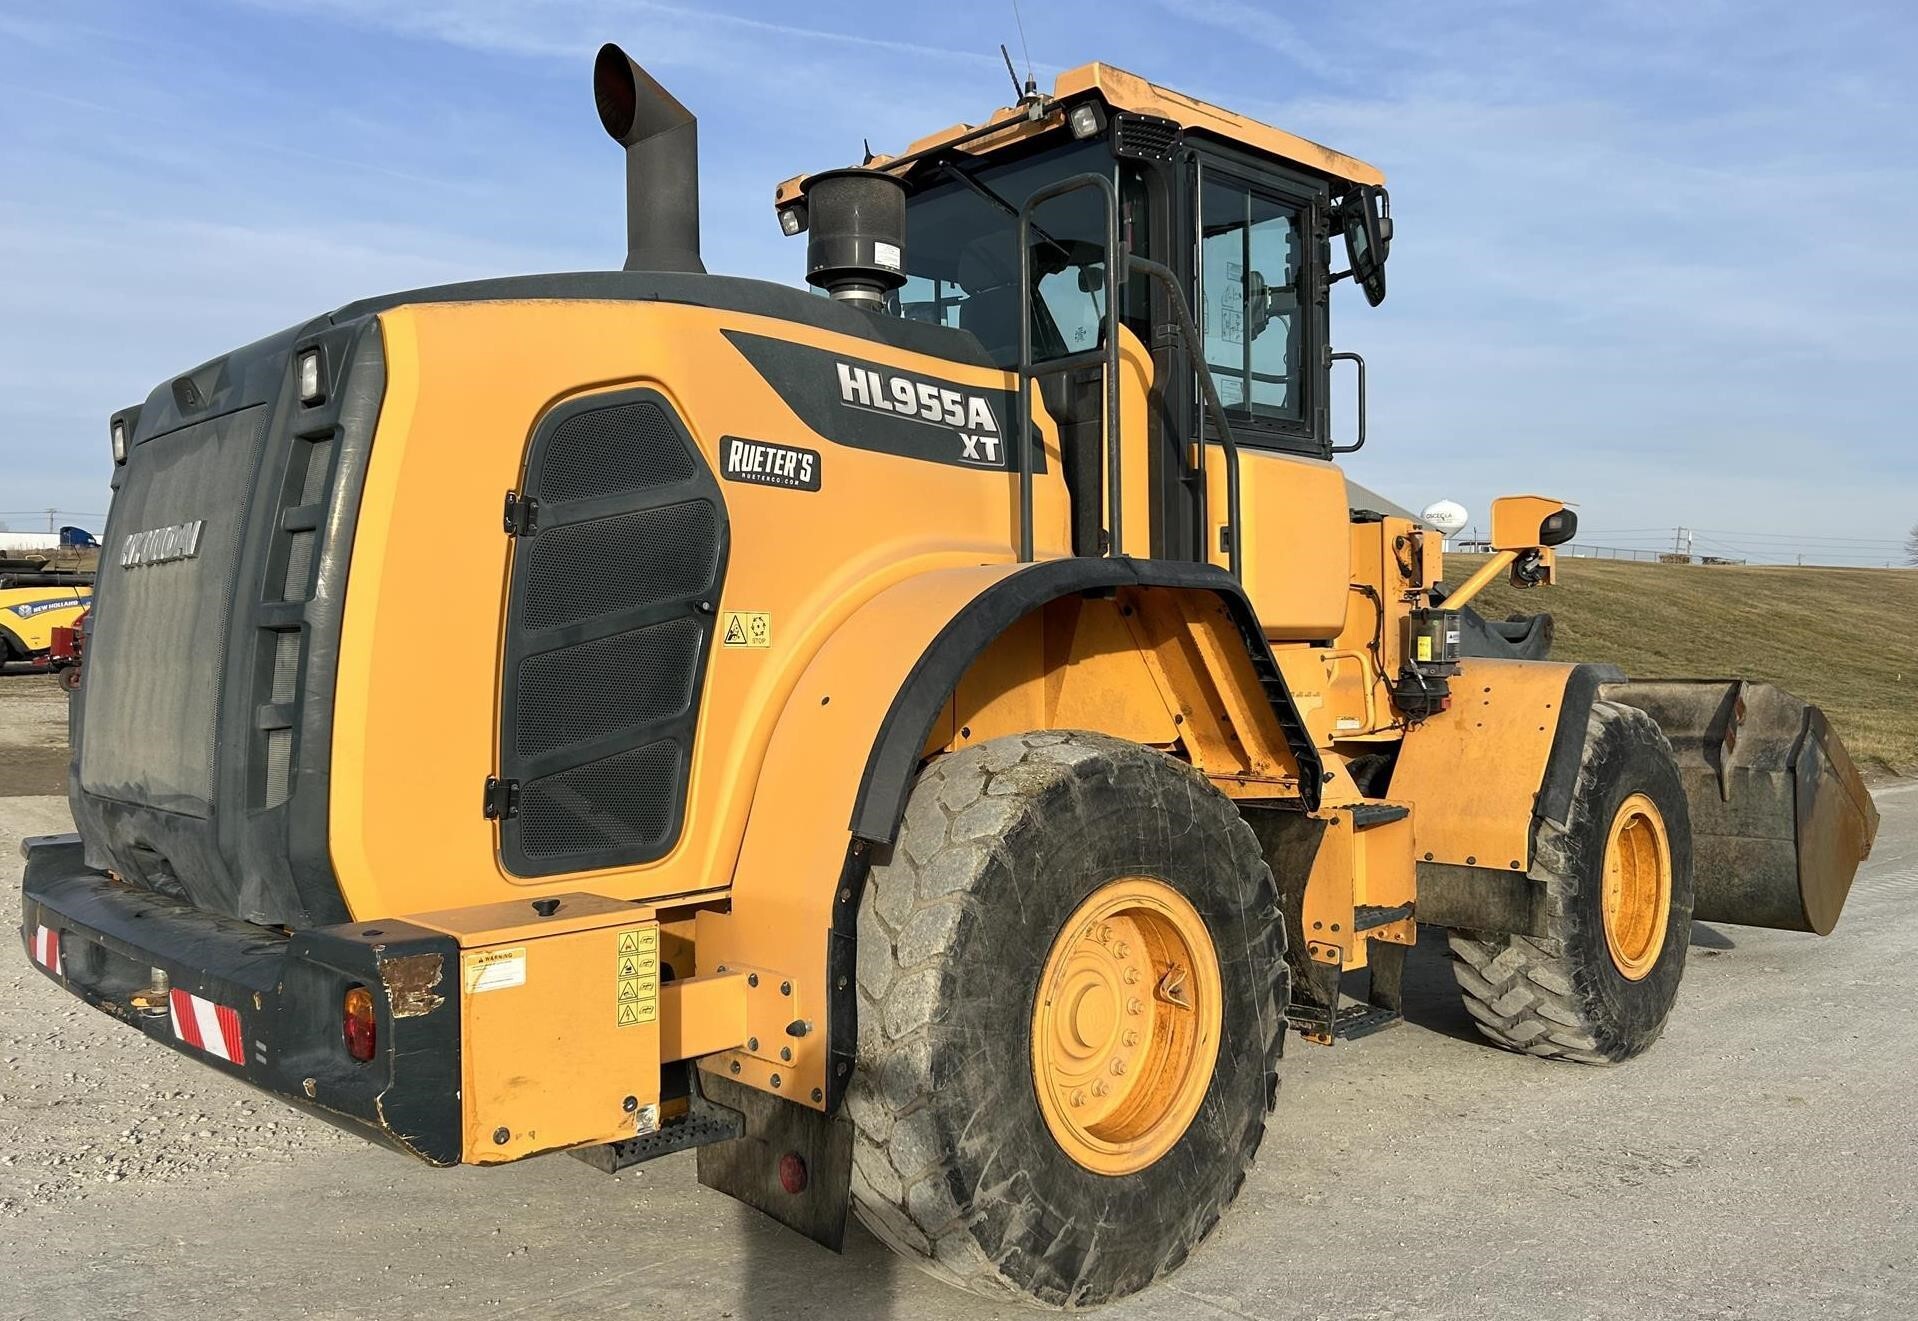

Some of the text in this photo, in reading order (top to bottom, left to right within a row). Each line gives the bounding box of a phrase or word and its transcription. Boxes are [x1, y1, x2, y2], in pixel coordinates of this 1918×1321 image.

[836, 362, 998, 432] HL955A
[959, 432, 999, 462] XT
[728, 440, 814, 482] RUETER'S
[741, 472, 799, 486] RUETERCO.COM
[33, 604, 48, 613] NEW
[48, 600, 79, 609] HOLLAND
[485, 952, 513, 961] WARNING
